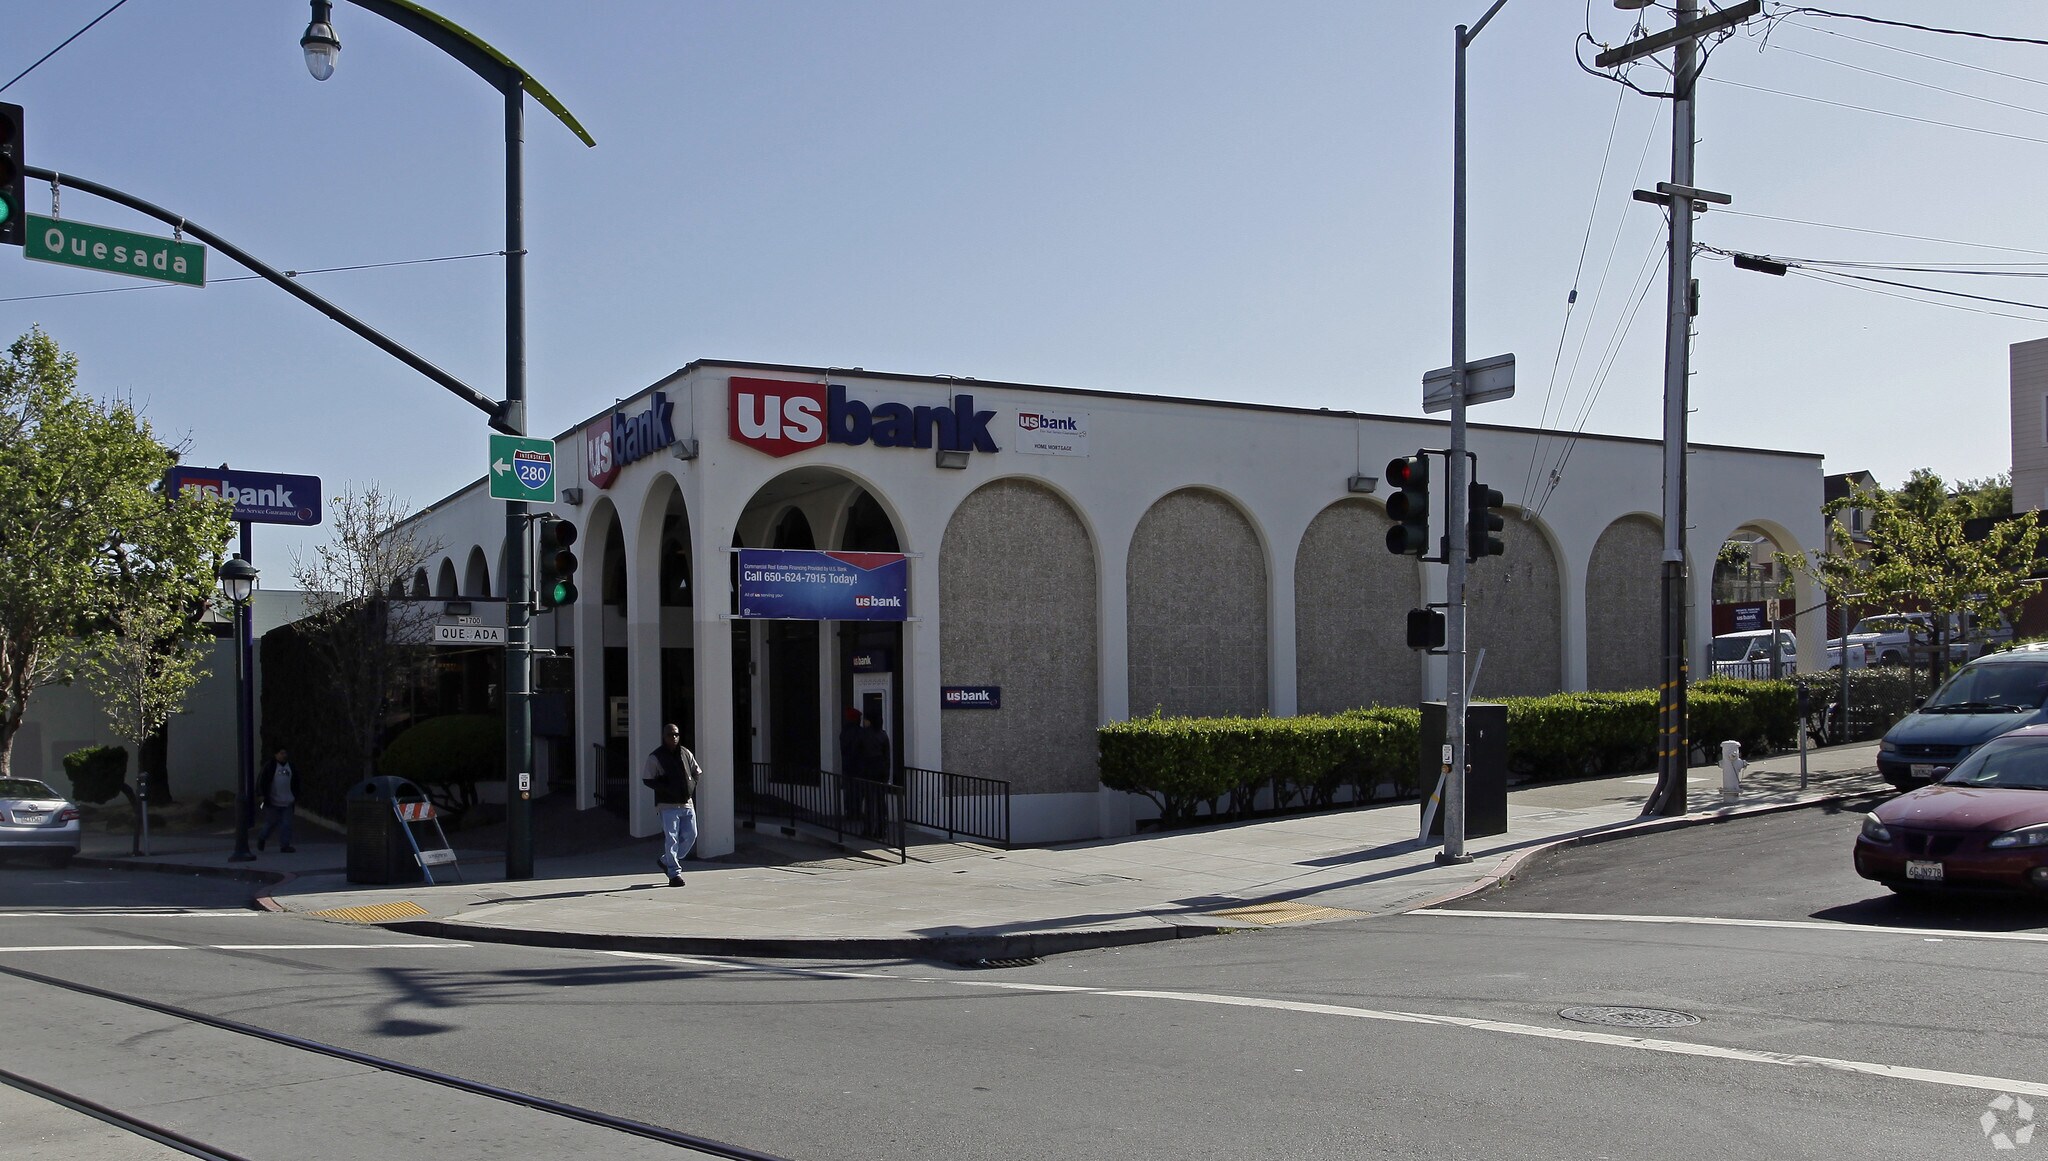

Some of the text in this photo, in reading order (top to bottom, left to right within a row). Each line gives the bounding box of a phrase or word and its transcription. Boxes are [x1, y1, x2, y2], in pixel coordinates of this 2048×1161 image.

[44, 228, 187, 274] Quesada
[521, 465, 546, 482] 280
[266, 508, 297, 516] Guaranteed
[744, 571, 857, 586] Call 650-624-7915 Today!
[442, 628, 498, 640] QUEADA
